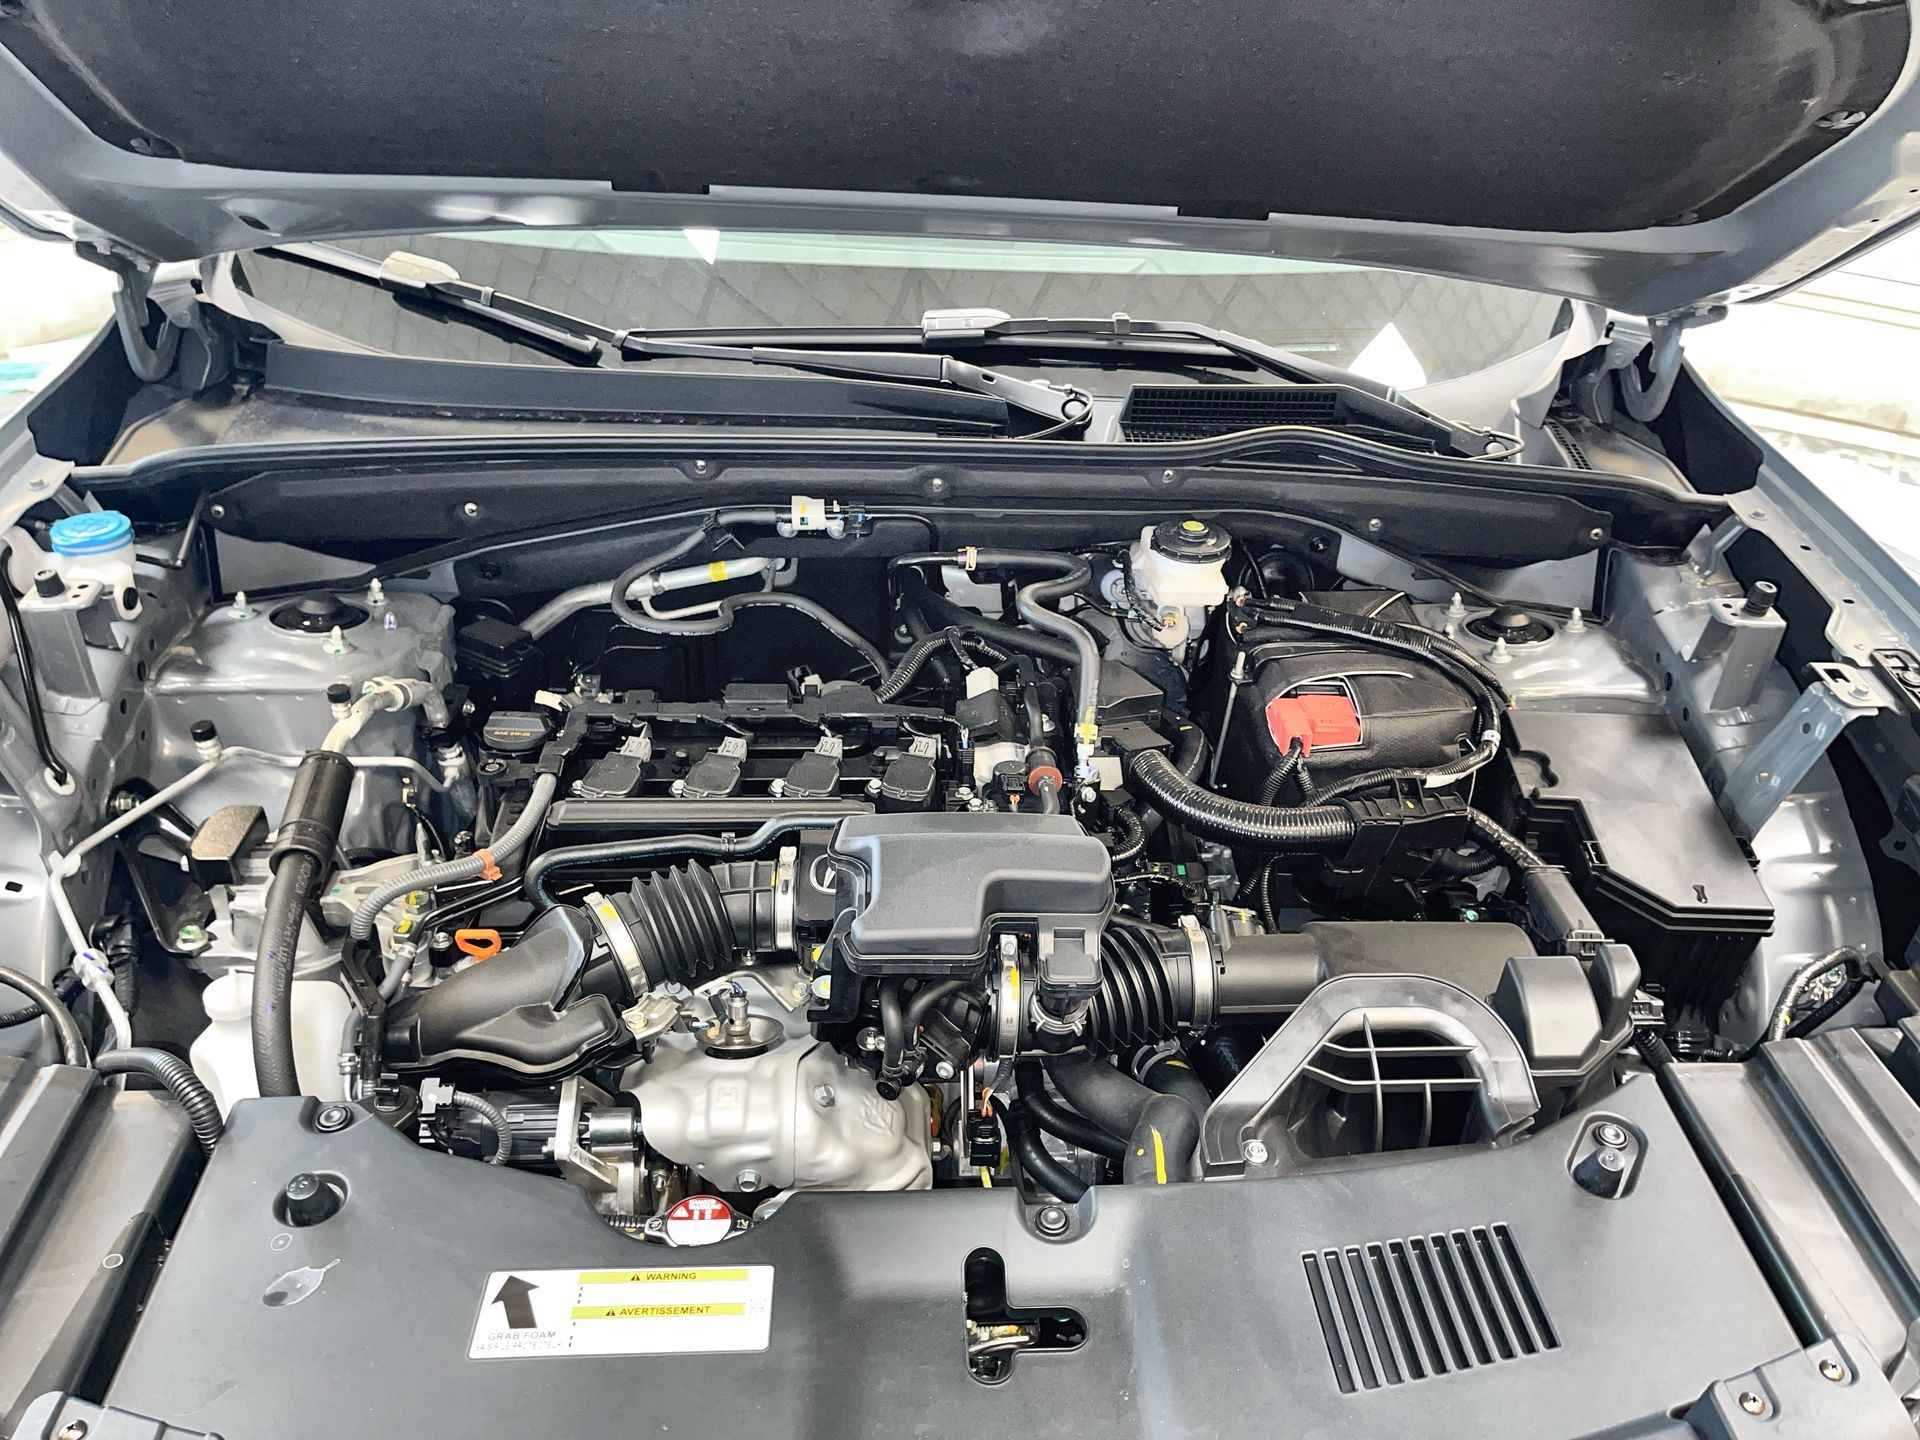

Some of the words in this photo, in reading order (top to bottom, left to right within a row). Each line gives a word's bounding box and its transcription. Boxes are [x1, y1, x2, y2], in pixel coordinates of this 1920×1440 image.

[646, 1272, 697, 1281] WARNING
[620, 1306, 711, 1316] AVERTISSEMENT
[488, 1332, 520, 1341] GRAB
[524, 1331, 556, 1339] FOAM
